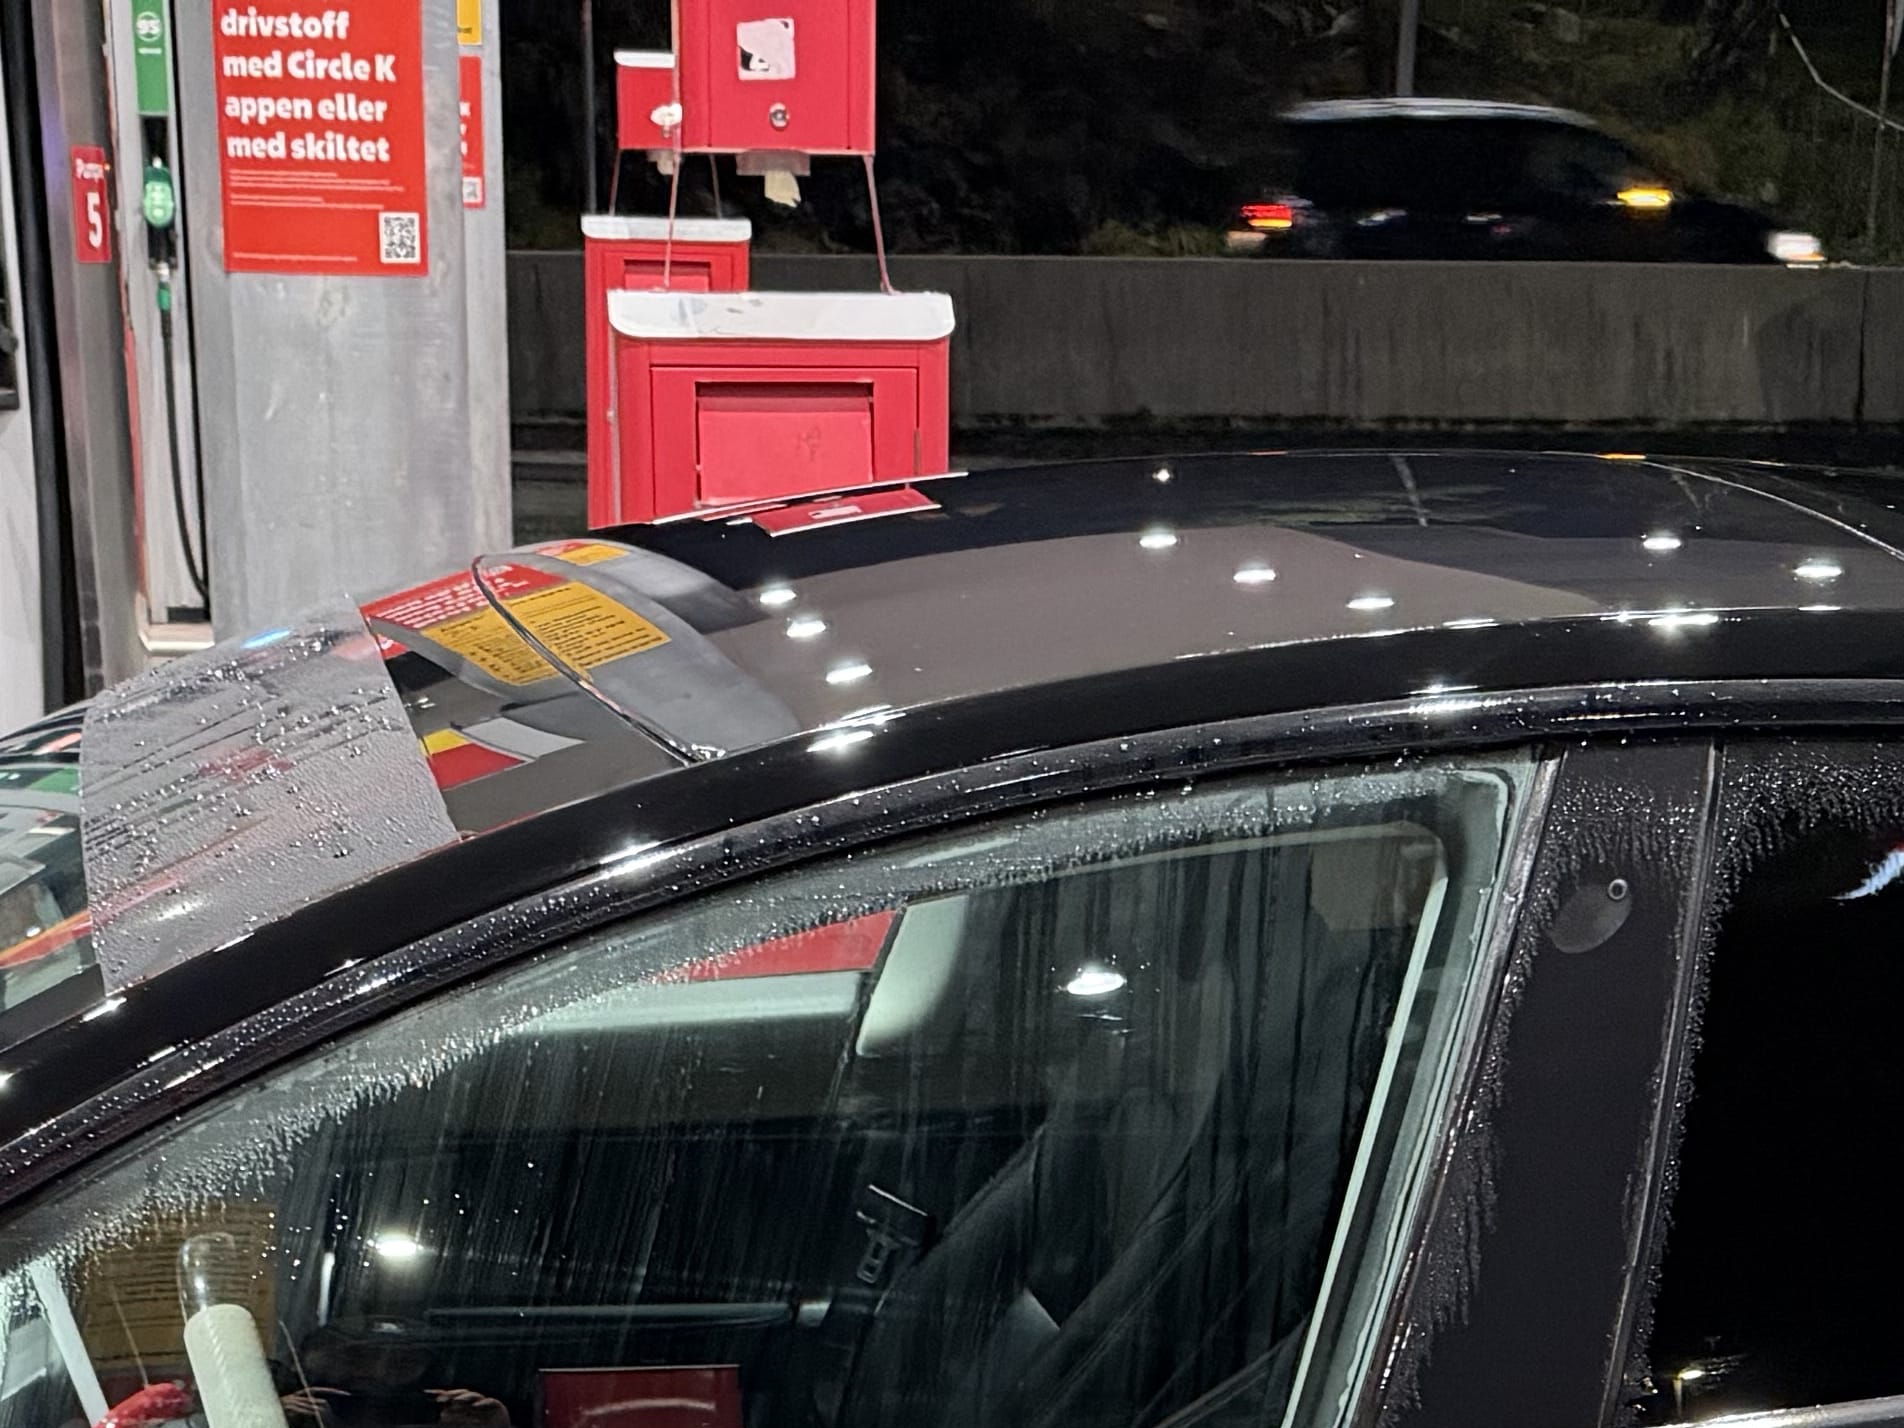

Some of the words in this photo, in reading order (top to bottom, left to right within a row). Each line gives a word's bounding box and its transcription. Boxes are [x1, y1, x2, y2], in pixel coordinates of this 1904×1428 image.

[221, 7, 350, 39] drivstoff
[223, 50, 282, 77] med
[287, 49, 371, 80] Circle
[375, 54, 397, 82] K
[225, 96, 313, 125] appen
[317, 93, 388, 122] eller
[226, 131, 286, 158] med
[290, 130, 390, 162] skiltet
[87, 192, 103, 247] 5
